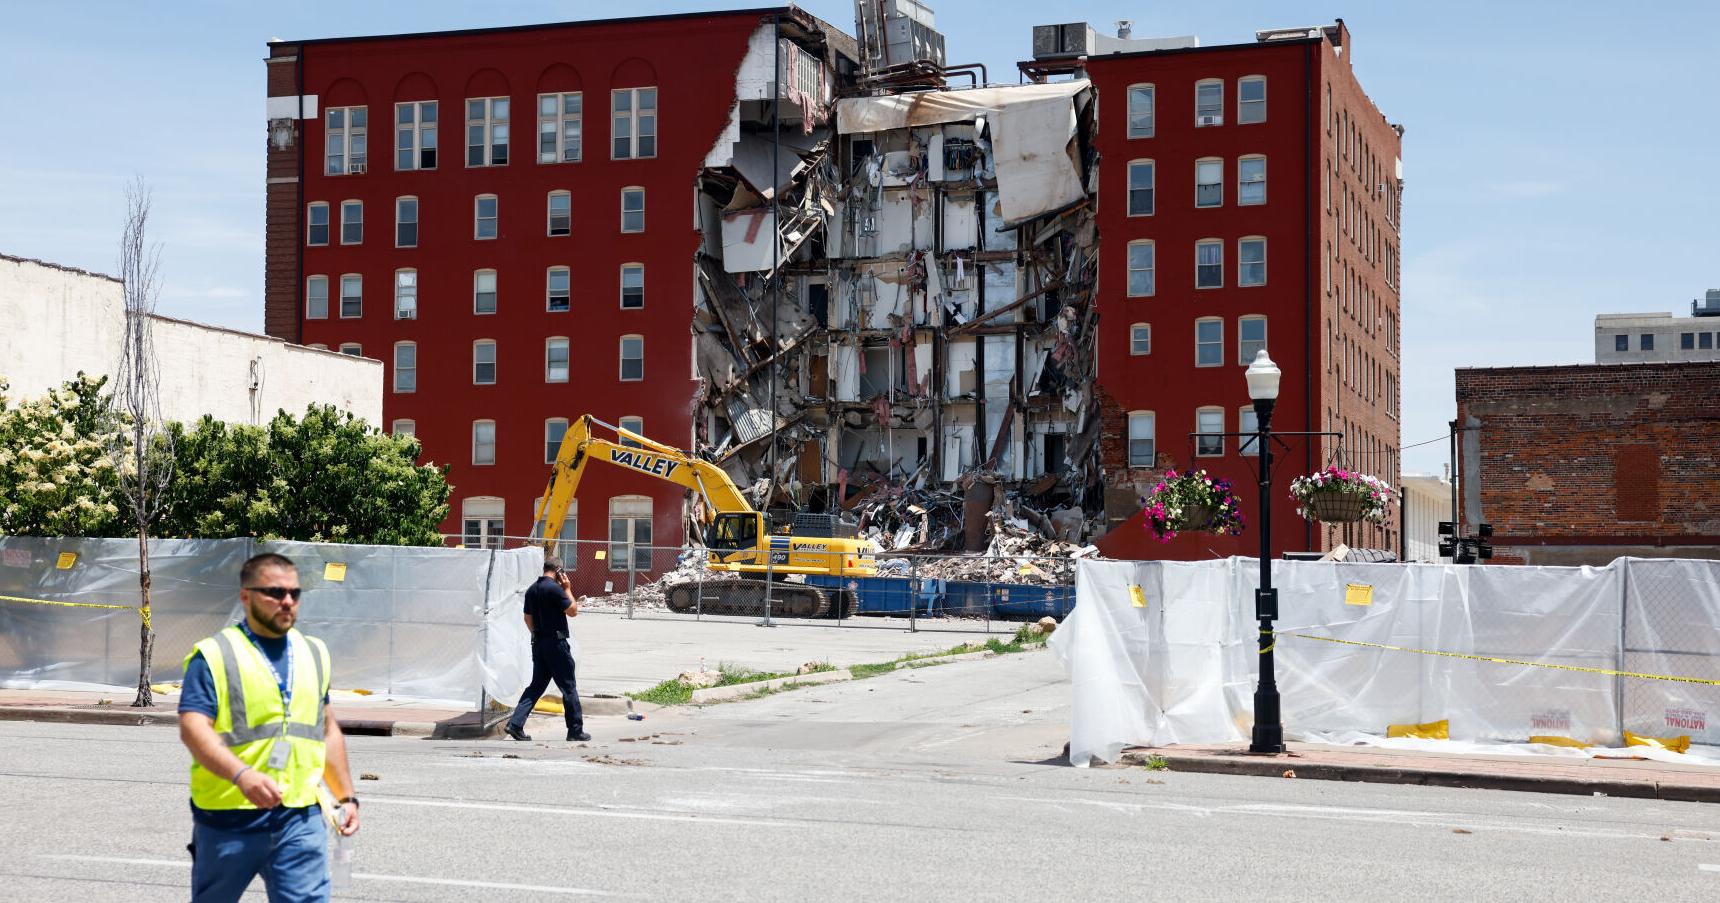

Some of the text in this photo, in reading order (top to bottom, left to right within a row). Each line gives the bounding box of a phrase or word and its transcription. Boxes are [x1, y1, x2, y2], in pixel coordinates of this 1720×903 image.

[611, 449, 679, 478] VALLEY
[793, 543, 827, 551] VALLEY
[1664, 717, 1705, 730] NATIONAL
